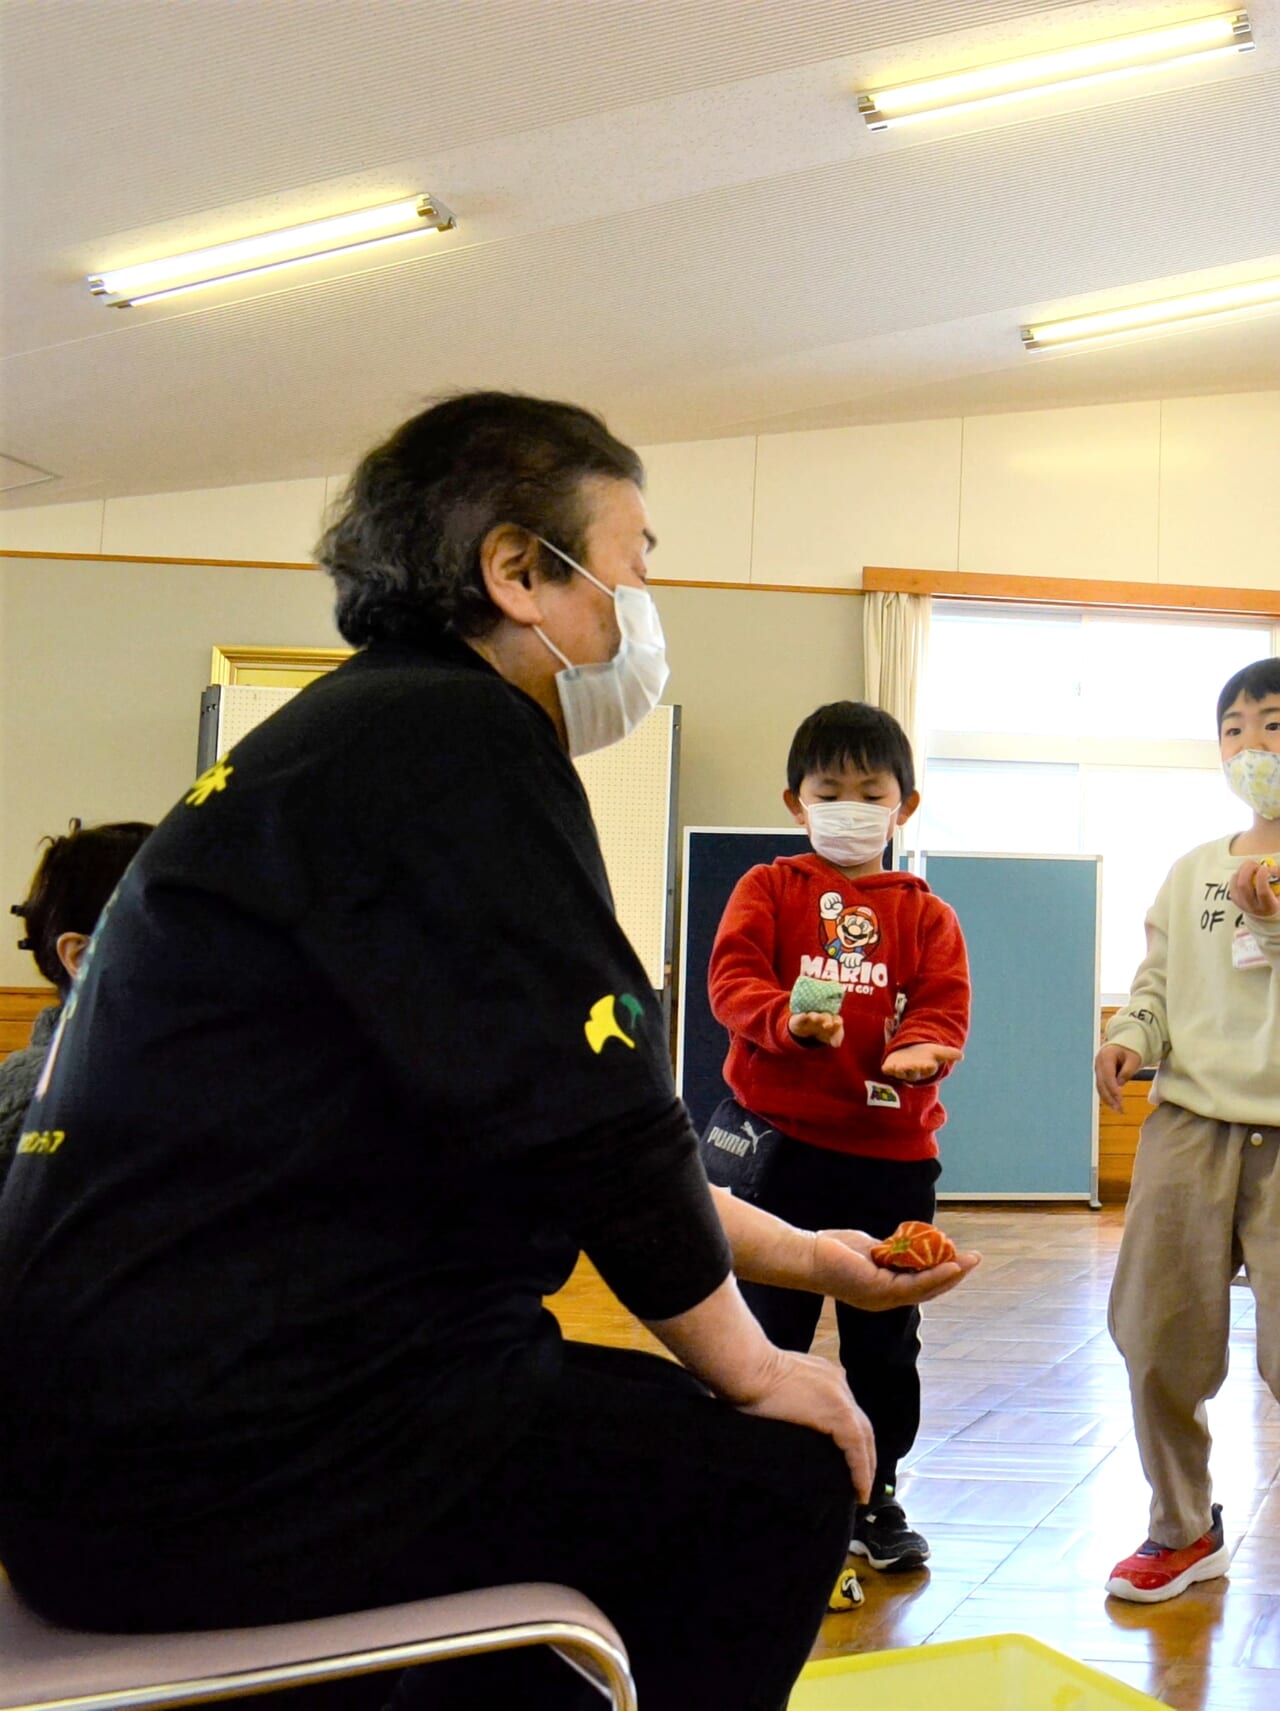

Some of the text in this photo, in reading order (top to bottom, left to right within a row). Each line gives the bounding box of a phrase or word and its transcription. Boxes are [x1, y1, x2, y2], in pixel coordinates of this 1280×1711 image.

[1200, 909, 1225, 932] OF
[800, 954, 888, 988] MARIO
[707, 1126, 751, 1157] PUMA
